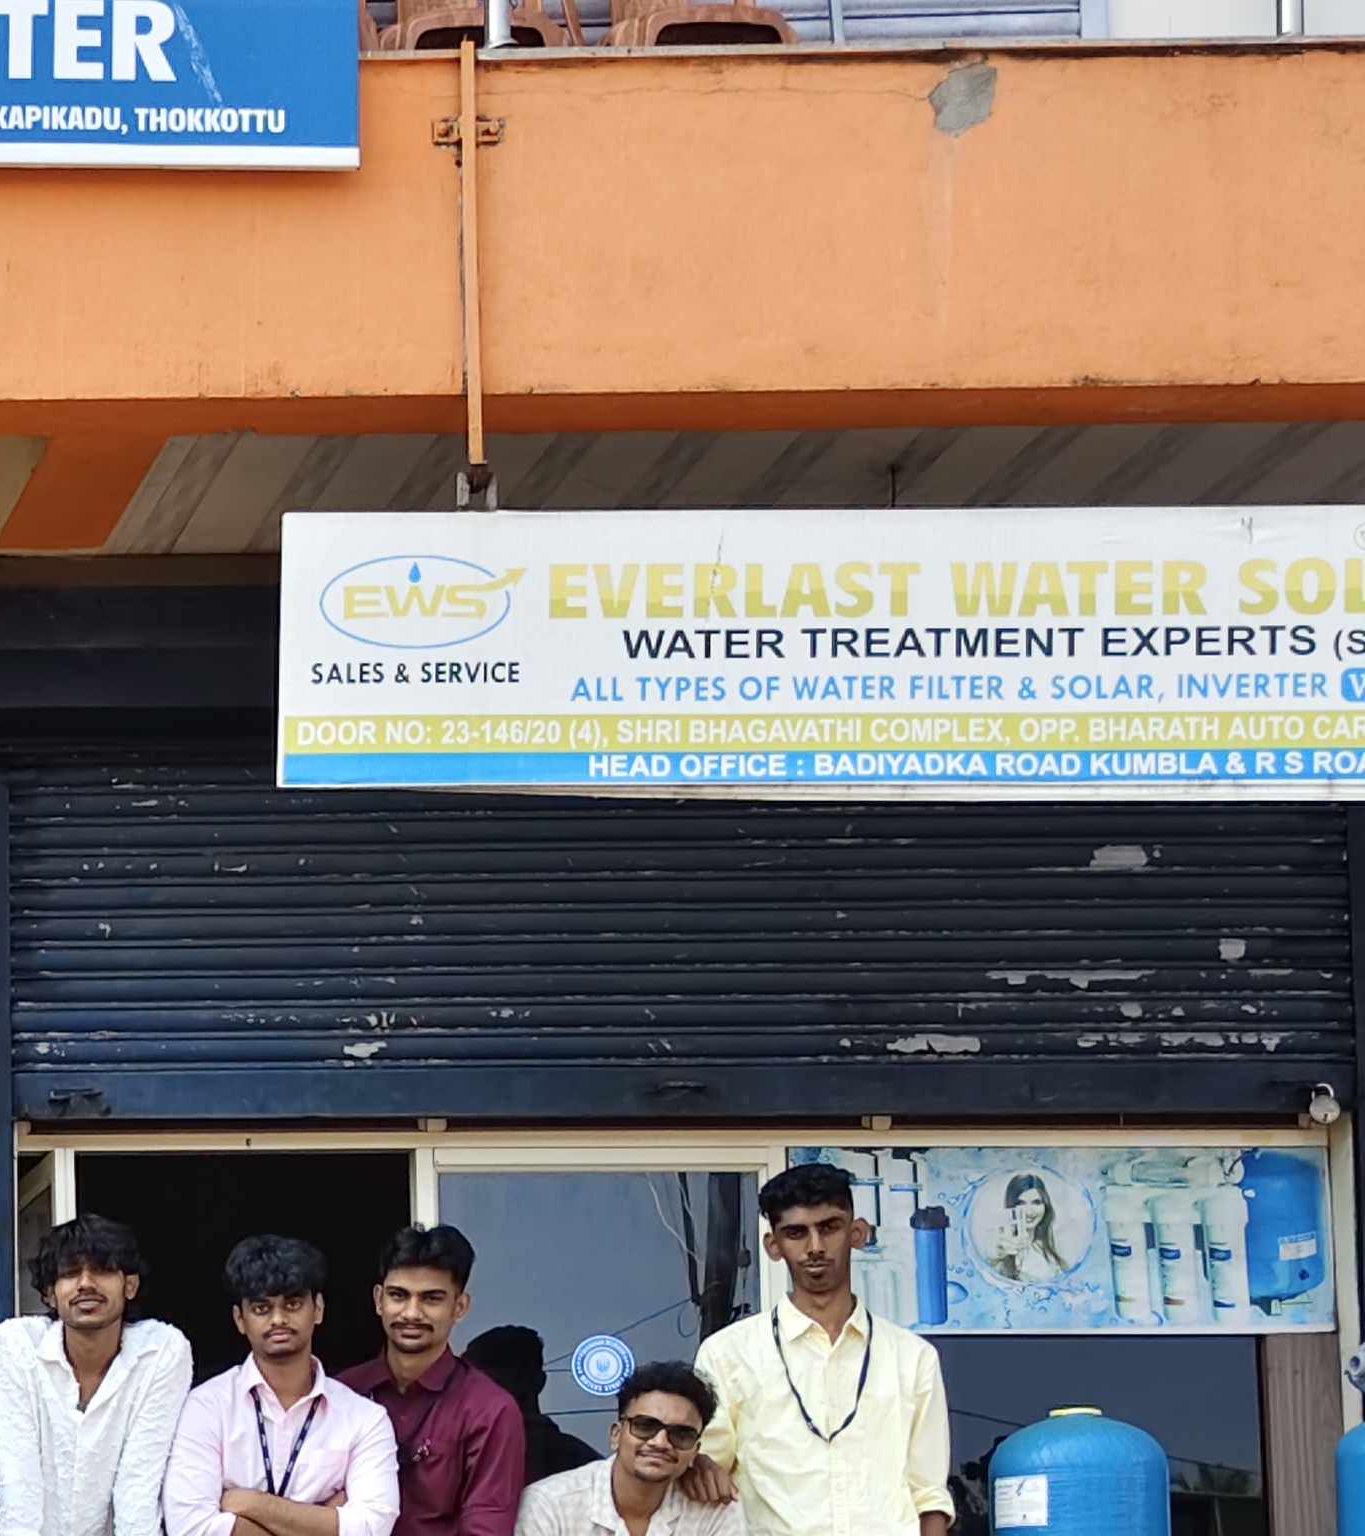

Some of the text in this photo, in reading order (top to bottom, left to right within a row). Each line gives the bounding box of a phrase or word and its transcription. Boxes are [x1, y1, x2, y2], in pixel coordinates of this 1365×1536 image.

[134, 107, 286, 134] THOKKOTTU
[342, 582, 489, 621] EWS
[547, 560, 921, 620] EVERLAST
[949, 558, 1208, 618] WATER
[623, 628, 786, 660] WATER
[801, 626, 1085, 659] TREATMENT
[1100, 624, 1317, 657] EXPERTS
[311, 661, 521, 684] SALES & SERVICE
[570, 672, 1328, 704] ALL TYPES OF WATER FILTER & SOLAR, INVERTER
[296, 721, 378, 746] DOOR
[385, 721, 432, 746] NO:
[441, 719, 562, 746] 23-146/20
[568, 719, 609, 749] (4),
[616, 718, 681, 744] SHRI
[688, 716, 862, 744] BHAGAVATHI
[870, 716, 1011, 746] COMPLEX,
[1018, 716, 1081, 743] OPP.
[1088, 715, 1220, 742] BHARATH
[1228, 715, 1305, 742] AUTO
[588, 754, 671, 778] HEAD
[678, 754, 788, 778] OFFICE
[814, 752, 988, 776] BADIYADKA
[995, 752, 1081, 776] ROAD
[1089, 751, 1219, 775] KUMBLA
[1227, 752, 1246, 775] &
[1255, 752, 1276, 774] R
[1284, 751, 1305, 774] S
